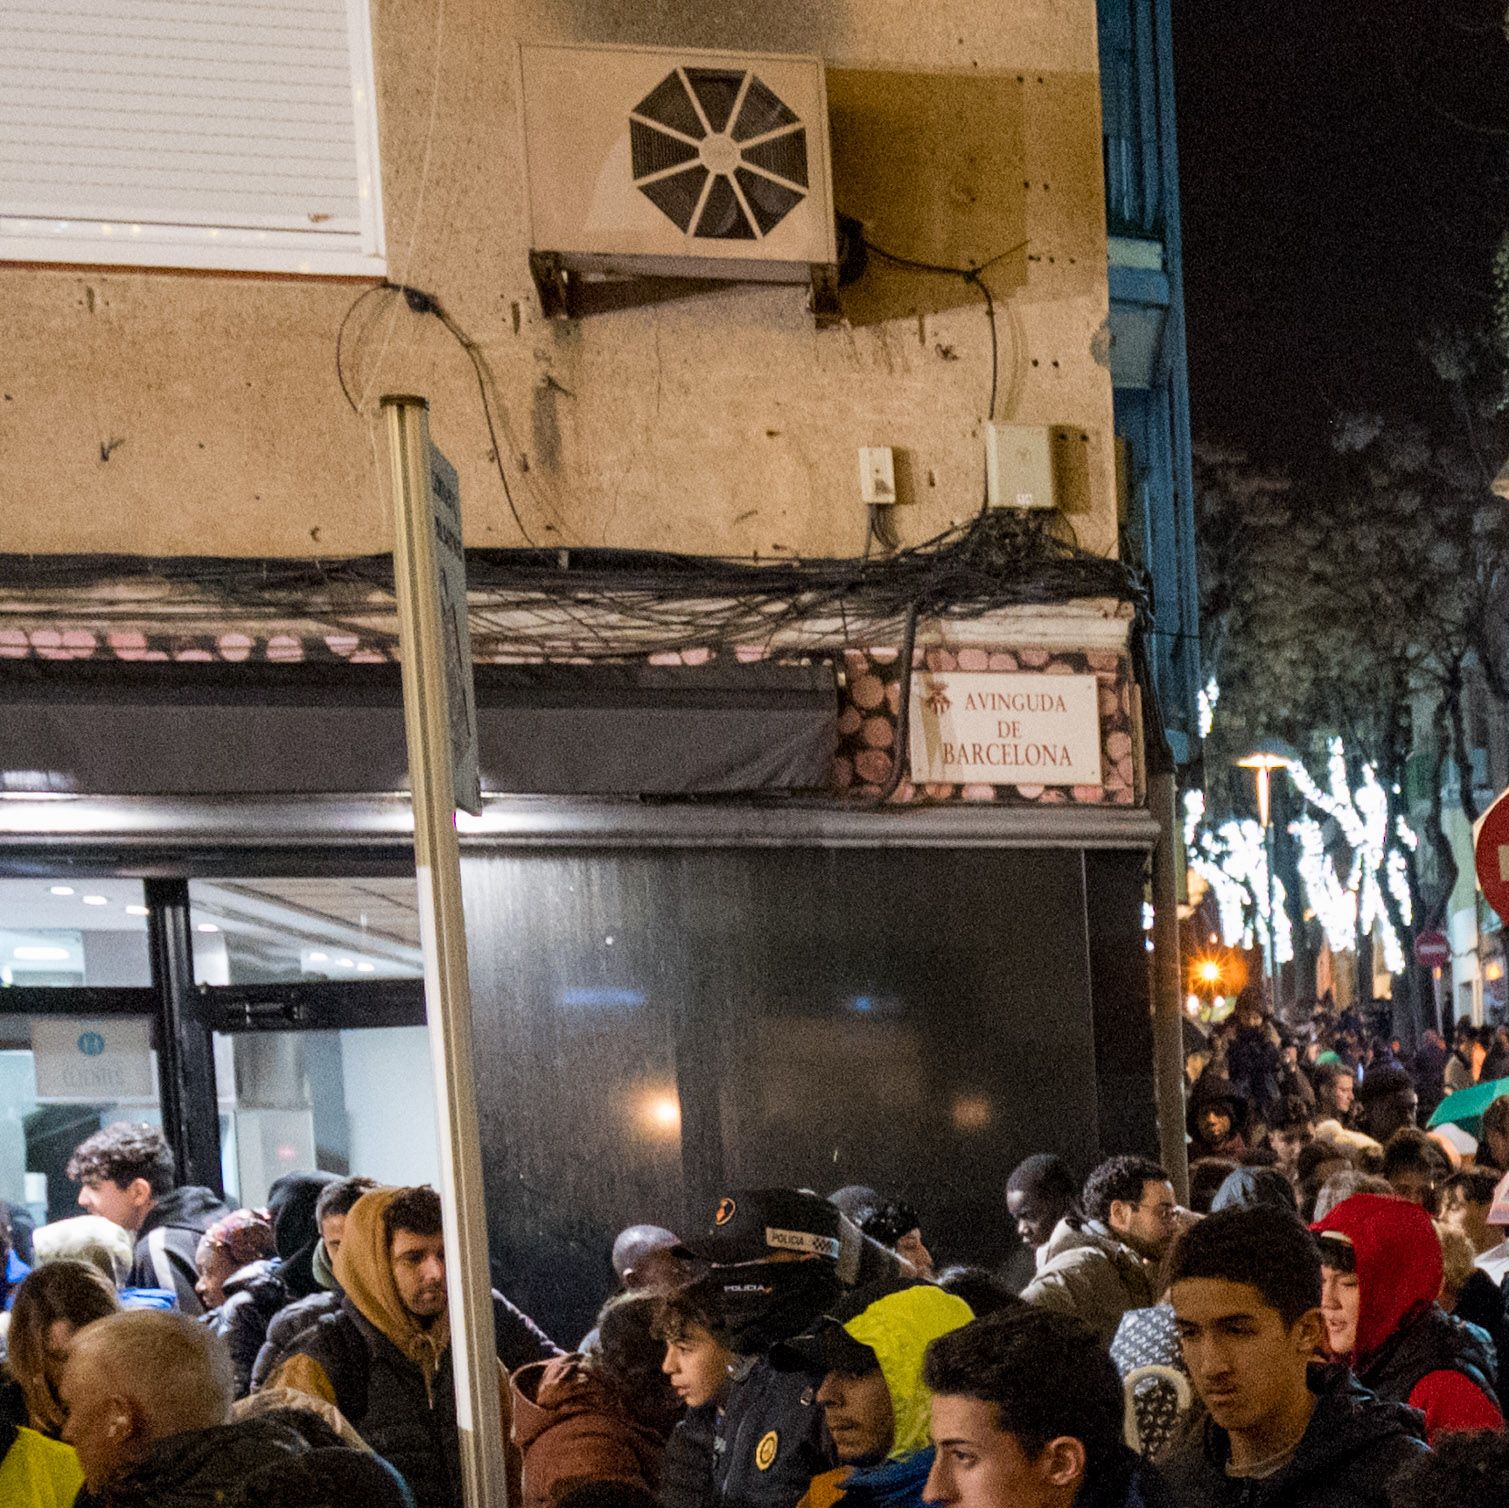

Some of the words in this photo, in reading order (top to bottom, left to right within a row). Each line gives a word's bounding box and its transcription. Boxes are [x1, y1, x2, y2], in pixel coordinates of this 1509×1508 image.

[965, 692, 1067, 712] AVINGUDA
[997, 720, 1022, 738] DE
[943, 743, 1073, 766] BARCELONA
[723, 1284, 765, 1292] POLICIA
